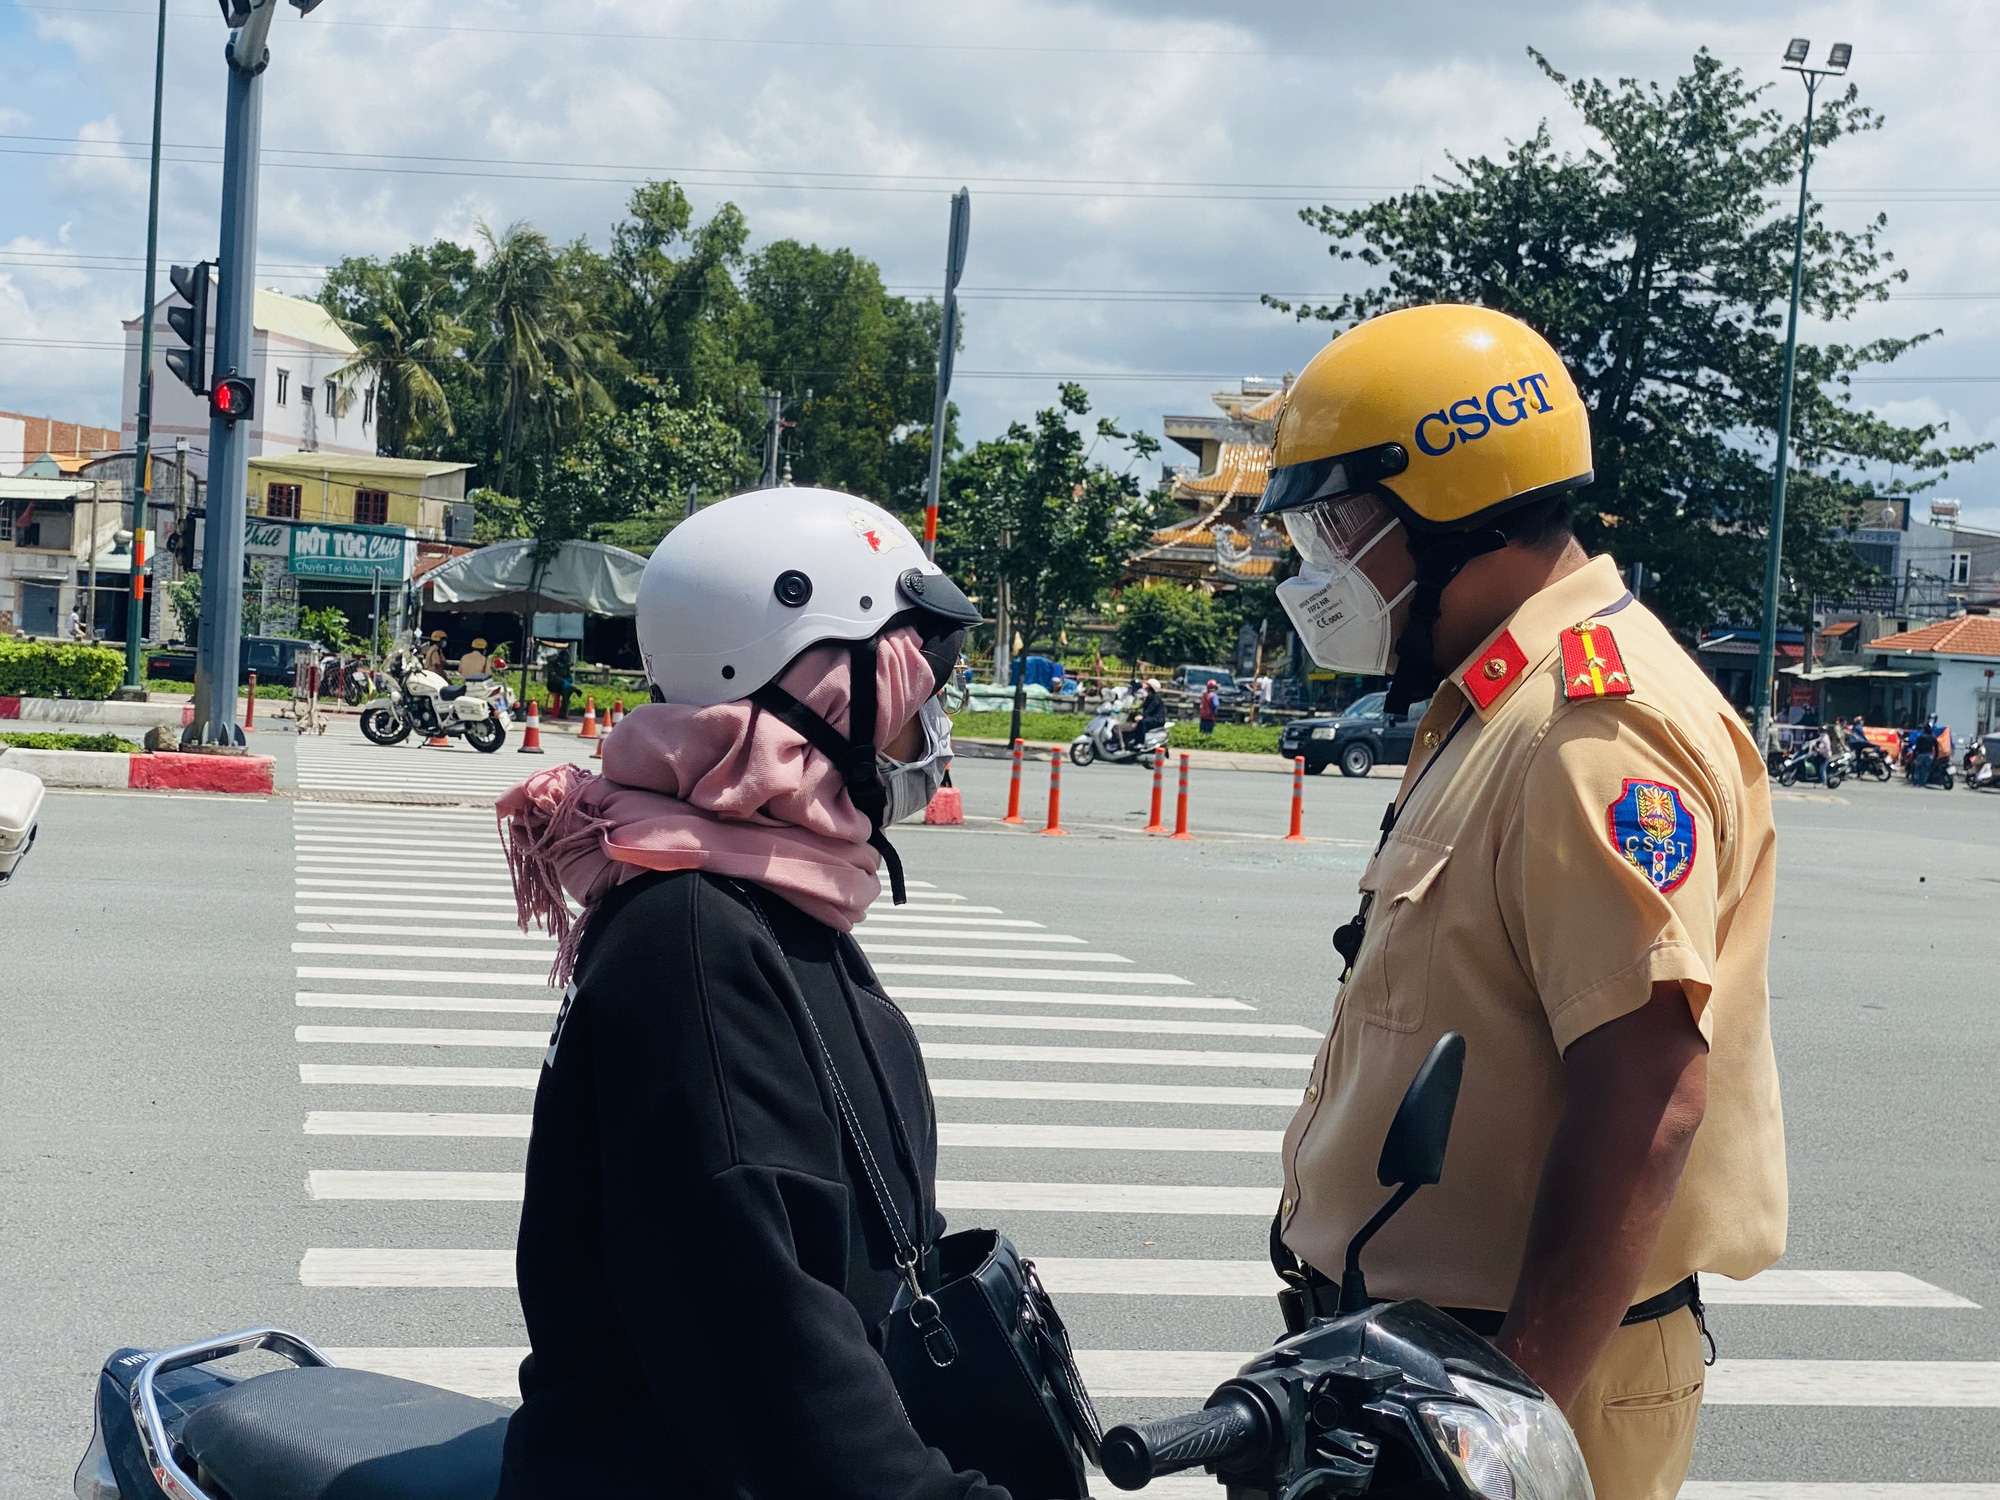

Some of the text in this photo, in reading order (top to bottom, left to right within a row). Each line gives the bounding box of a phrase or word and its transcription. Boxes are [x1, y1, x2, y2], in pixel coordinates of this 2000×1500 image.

[1414, 373, 1554, 457] CSGT
[1307, 602, 1321, 614] FFP2
[1319, 597, 1330, 606] NR
[1625, 836, 1688, 857] CSGT
